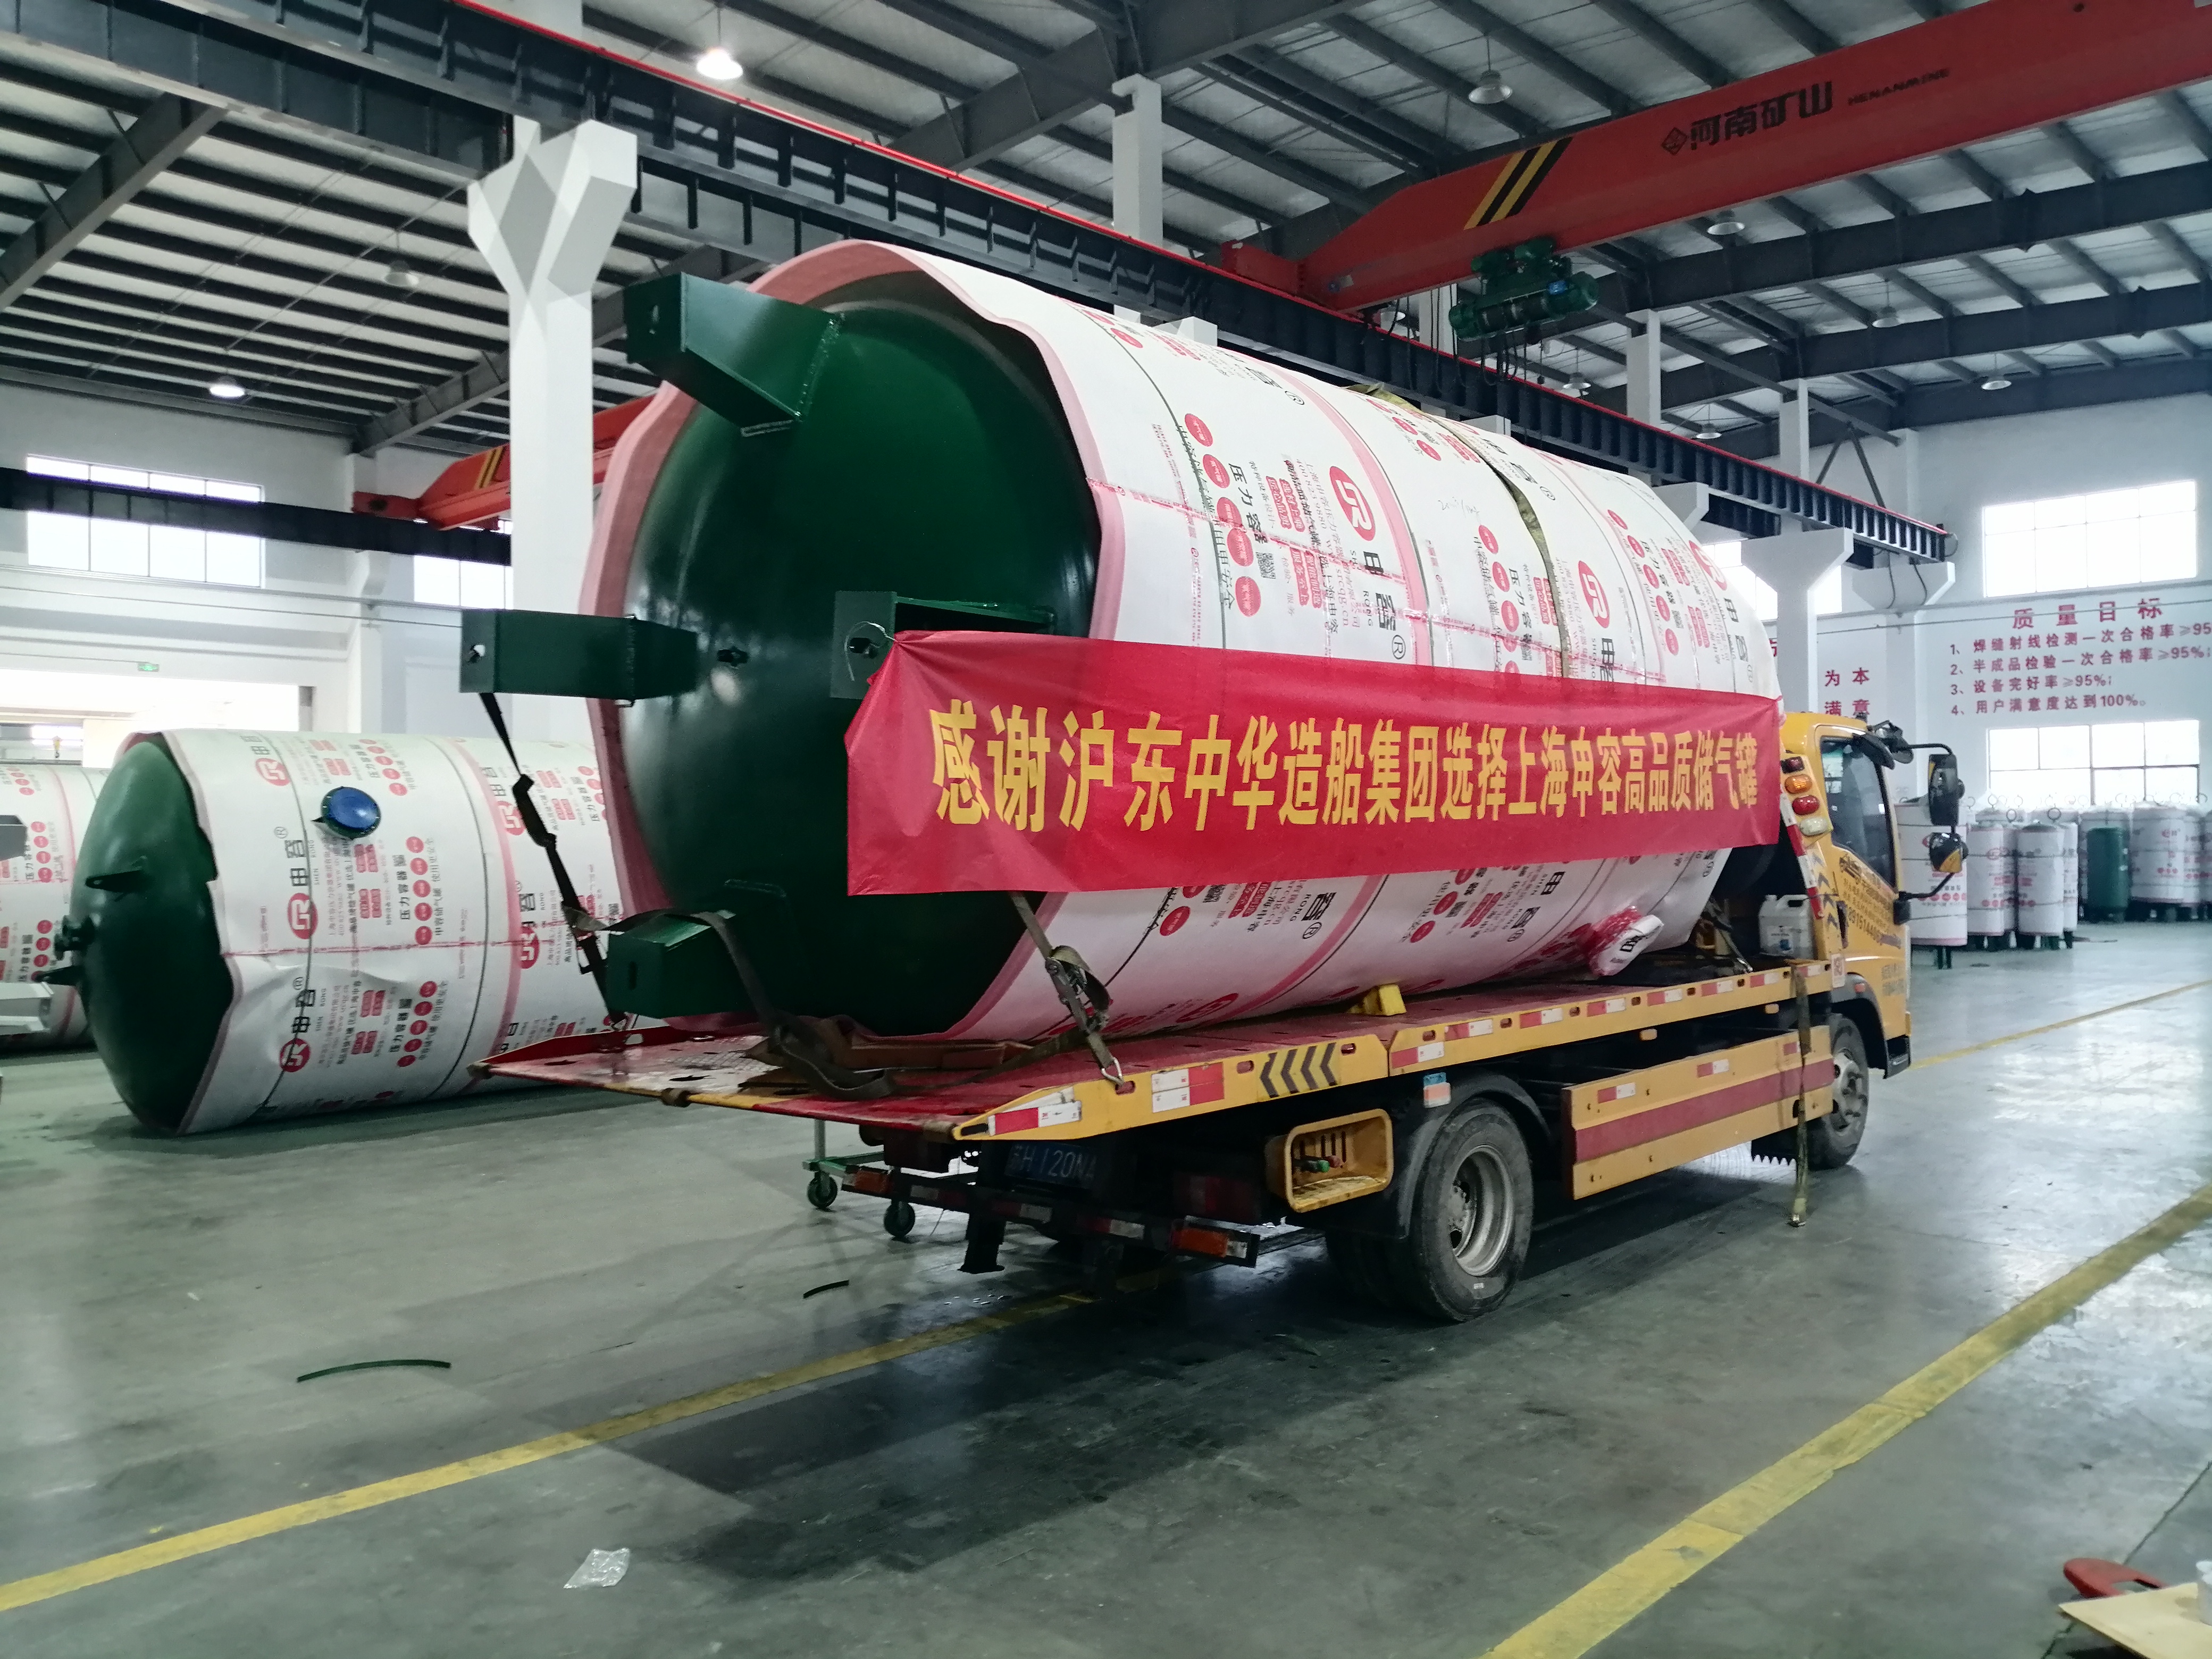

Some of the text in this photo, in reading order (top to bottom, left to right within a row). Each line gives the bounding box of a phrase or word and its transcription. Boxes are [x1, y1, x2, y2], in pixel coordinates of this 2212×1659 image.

[1690, 81, 1833, 151] 河南矿山
[1227, 463, 1268, 543] 压力容器
[2012, 598, 2163, 630] 质量目标
[1824, 667, 1870, 687] 为本
[929, 699, 1757, 832] 感谢沪东中华造船集团选择上海申容高品质储气罐
[397, 870, 410, 920] 压力容器
[1289, 893, 1312, 923] RONG
